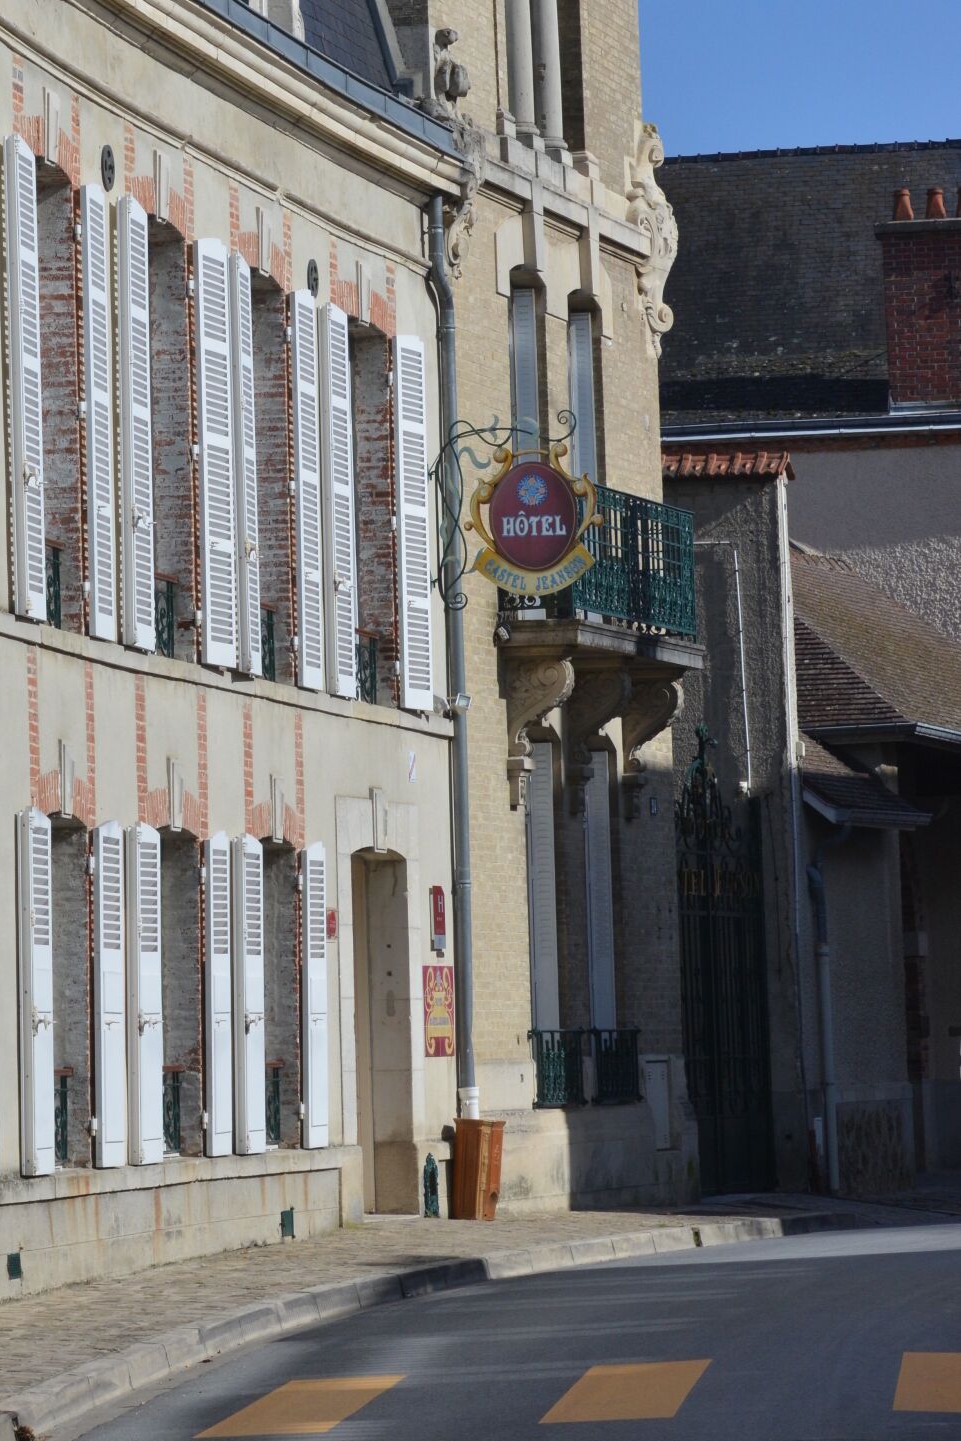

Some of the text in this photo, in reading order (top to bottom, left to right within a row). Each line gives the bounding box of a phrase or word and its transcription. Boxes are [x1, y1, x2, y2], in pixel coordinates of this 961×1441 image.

[502, 511, 567, 537] HÔTEL
[484, 555, 586, 591] CASTEL JEANSON
[437, 895, 444, 913] H
